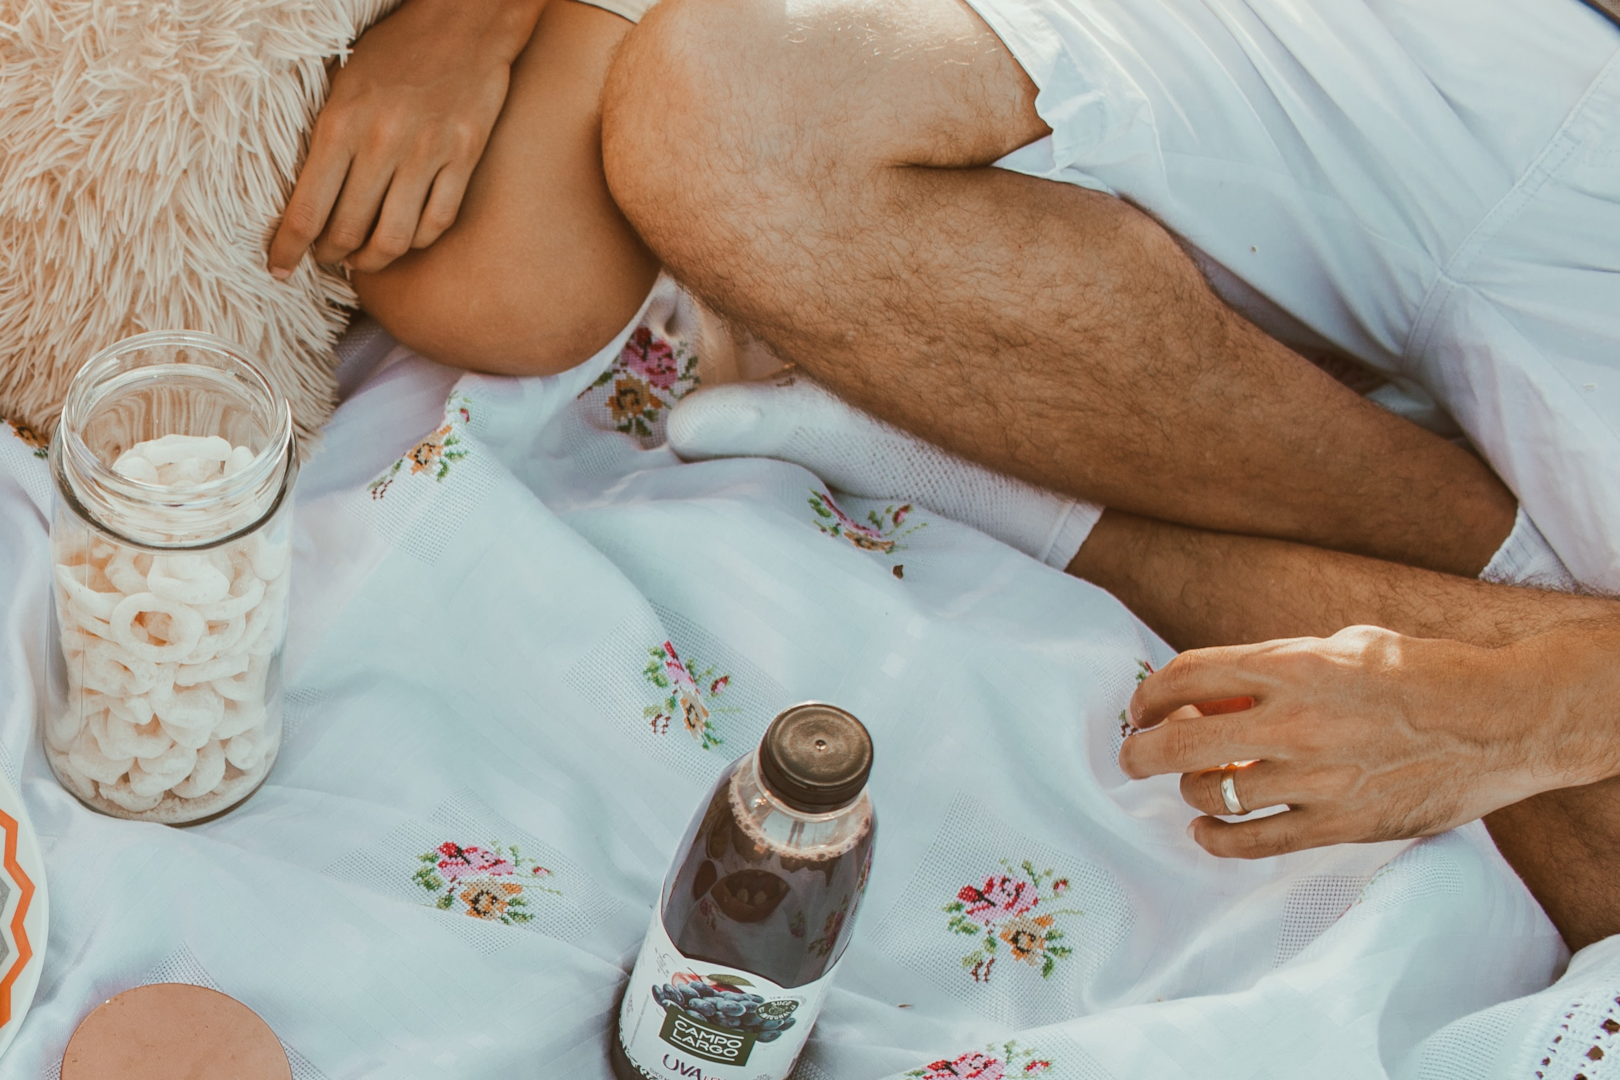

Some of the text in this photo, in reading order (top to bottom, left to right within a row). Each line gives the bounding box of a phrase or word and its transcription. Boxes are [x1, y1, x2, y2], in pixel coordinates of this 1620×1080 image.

[672, 1028, 738, 1057] LARGO
[674, 1020, 742, 1048] CAMPO
[649, 1068, 664, 1080] SUCO
